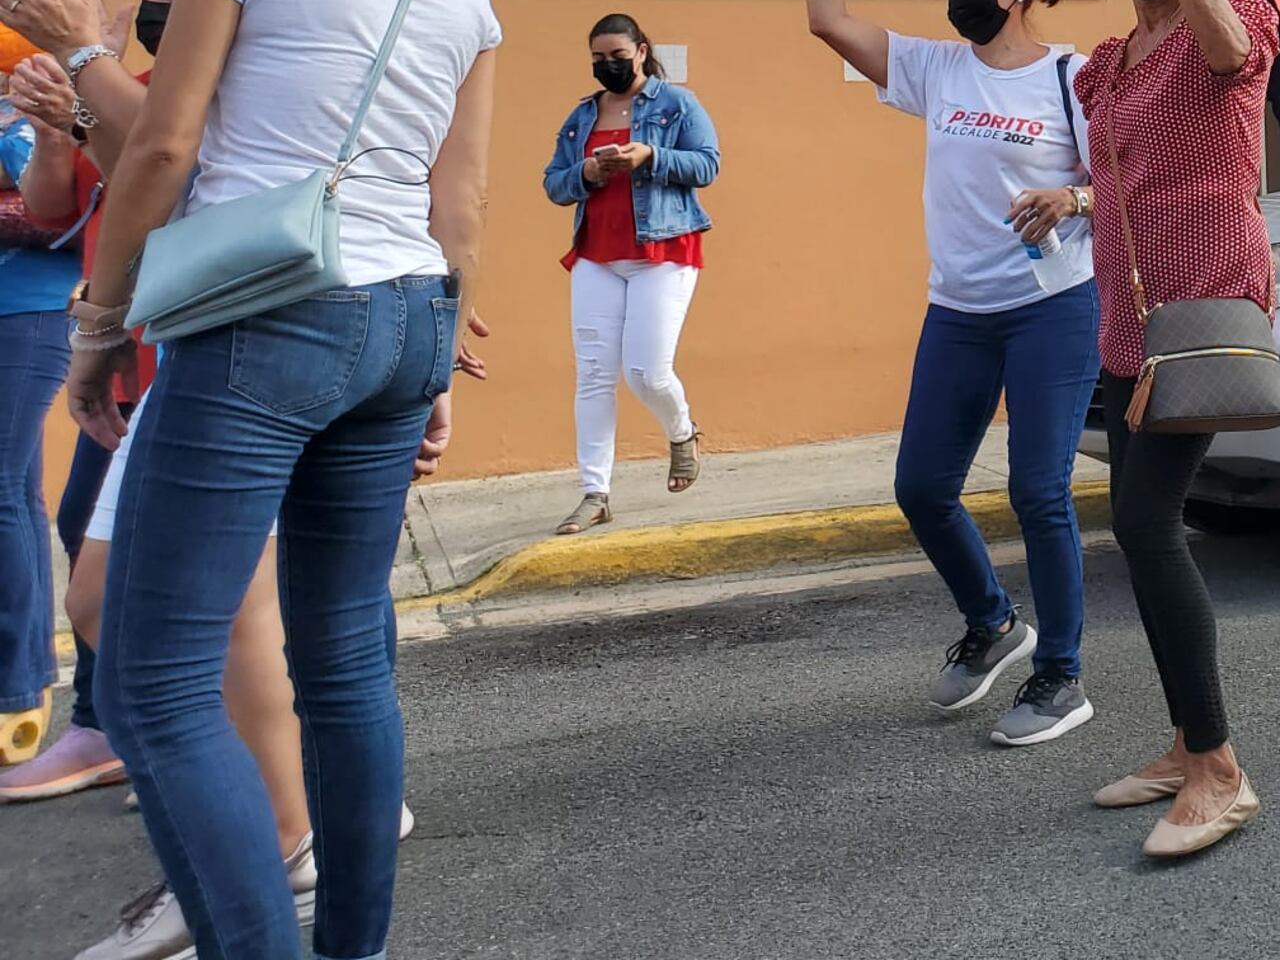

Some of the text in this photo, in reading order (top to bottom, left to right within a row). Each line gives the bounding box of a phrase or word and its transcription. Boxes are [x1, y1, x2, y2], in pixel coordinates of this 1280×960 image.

[948, 110, 1044, 136] PEDRITO
[942, 125, 1035, 146] ALCALDE 2022
